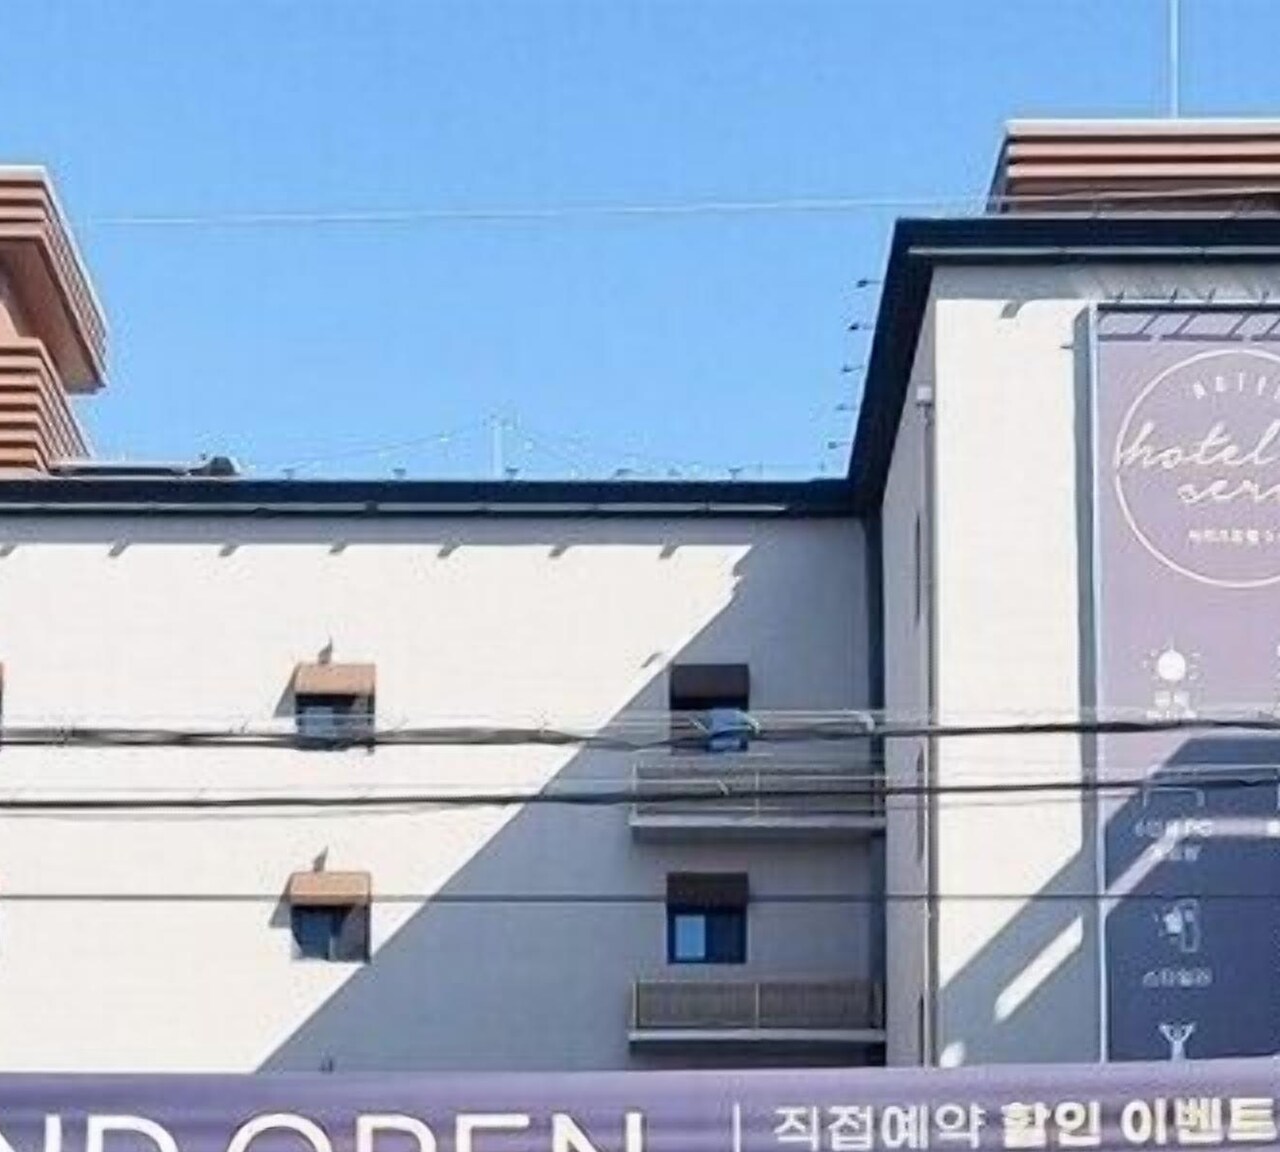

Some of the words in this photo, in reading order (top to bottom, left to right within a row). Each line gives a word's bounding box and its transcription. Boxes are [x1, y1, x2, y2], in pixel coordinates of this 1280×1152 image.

[774, 1103, 987, 1152] 직접예약
[1003, 1100, 1102, 1150] 할인
[1122, 1097, 1279, 1146] 이벤트
